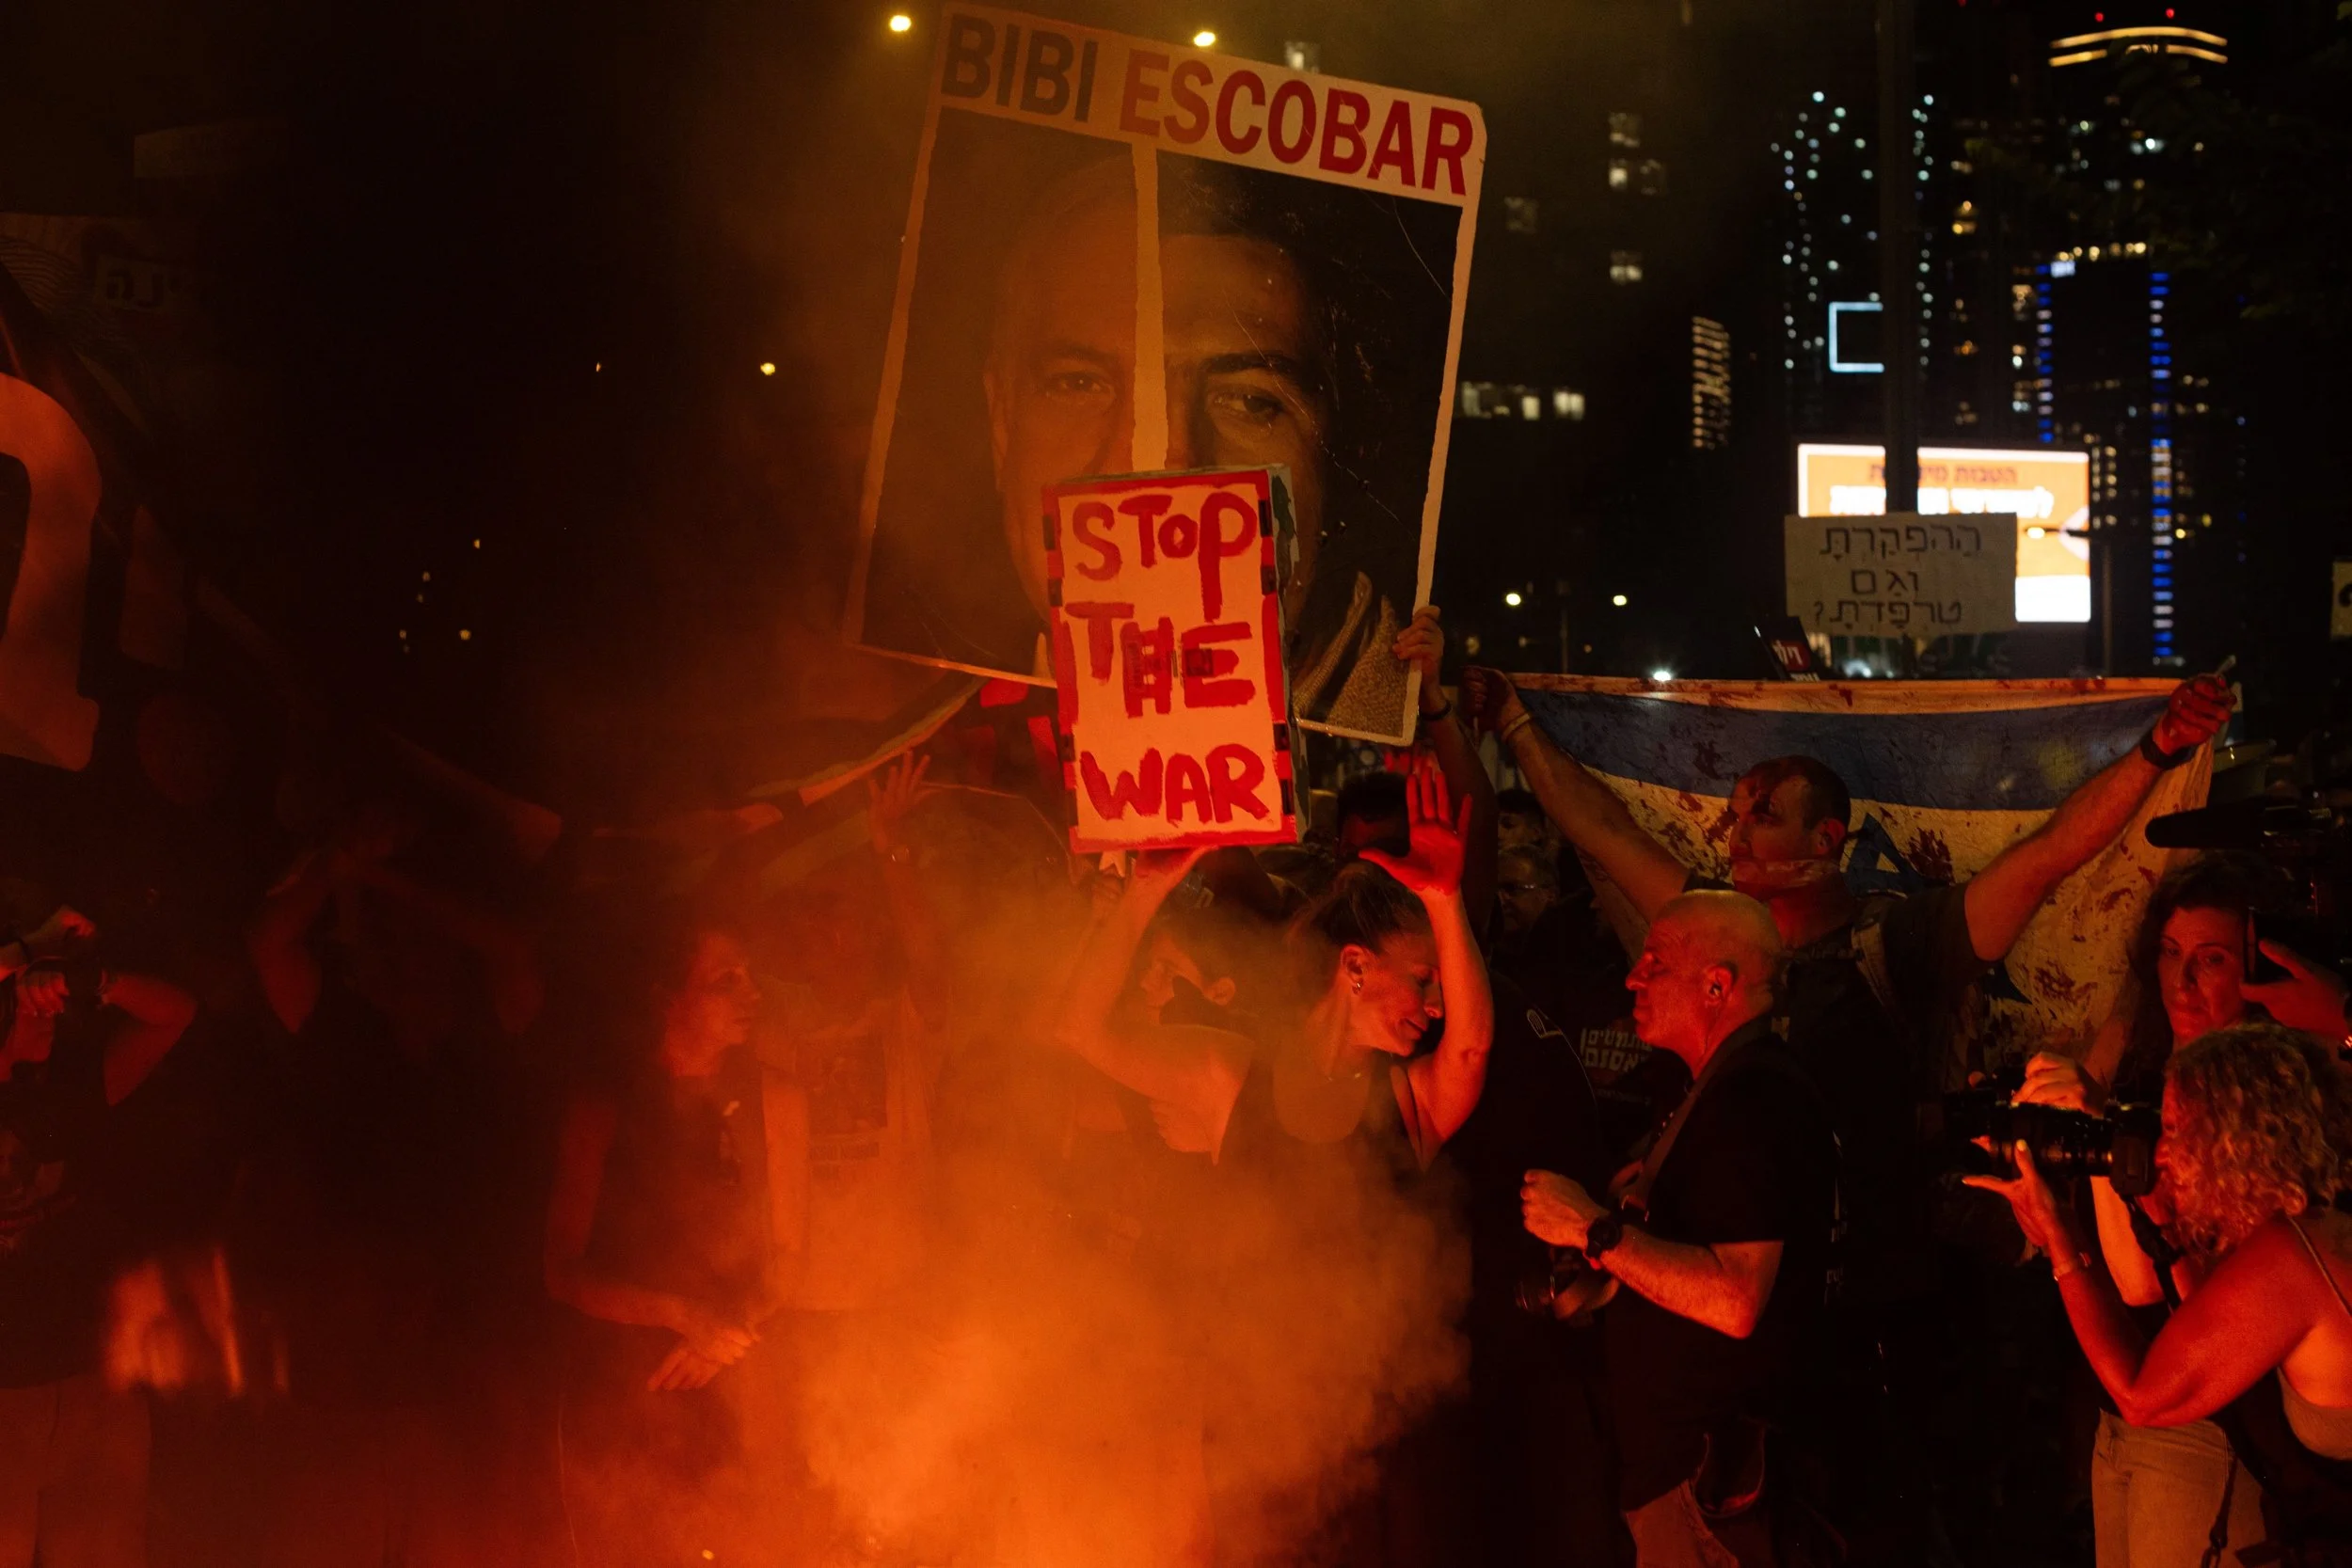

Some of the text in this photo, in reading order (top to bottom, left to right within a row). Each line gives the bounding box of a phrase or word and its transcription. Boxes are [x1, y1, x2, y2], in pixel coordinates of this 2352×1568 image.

[941, 13, 1475, 198] BIBI ESCOBAR
[1073, 491, 1258, 623] STOP
[1064, 601, 1257, 718] THE
[1080, 742, 1271, 828] WAR
